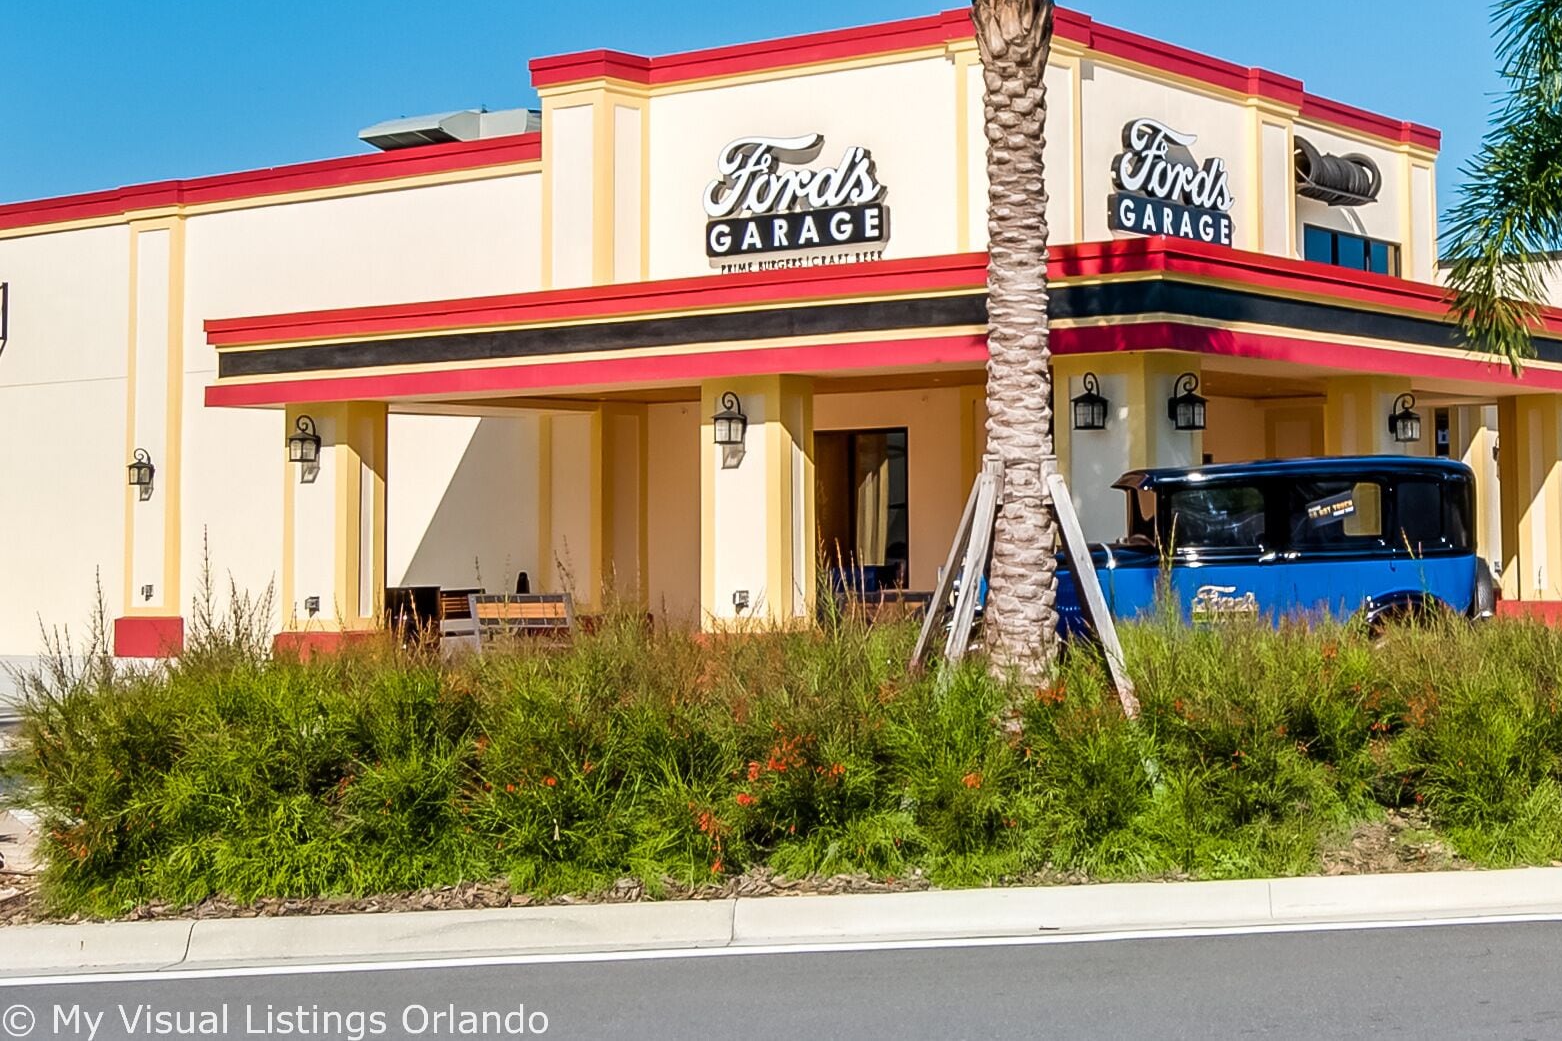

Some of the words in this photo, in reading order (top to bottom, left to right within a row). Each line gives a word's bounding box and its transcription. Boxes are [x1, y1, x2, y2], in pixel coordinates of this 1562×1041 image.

[703, 133, 881, 217] Ford's
[1119, 118, 1234, 211] Ford's
[709, 208, 880, 253] GARAGE
[1119, 199, 1230, 245] GARAGE
[721, 261, 753, 274] PRIME
[854, 250, 883, 262] BEER
